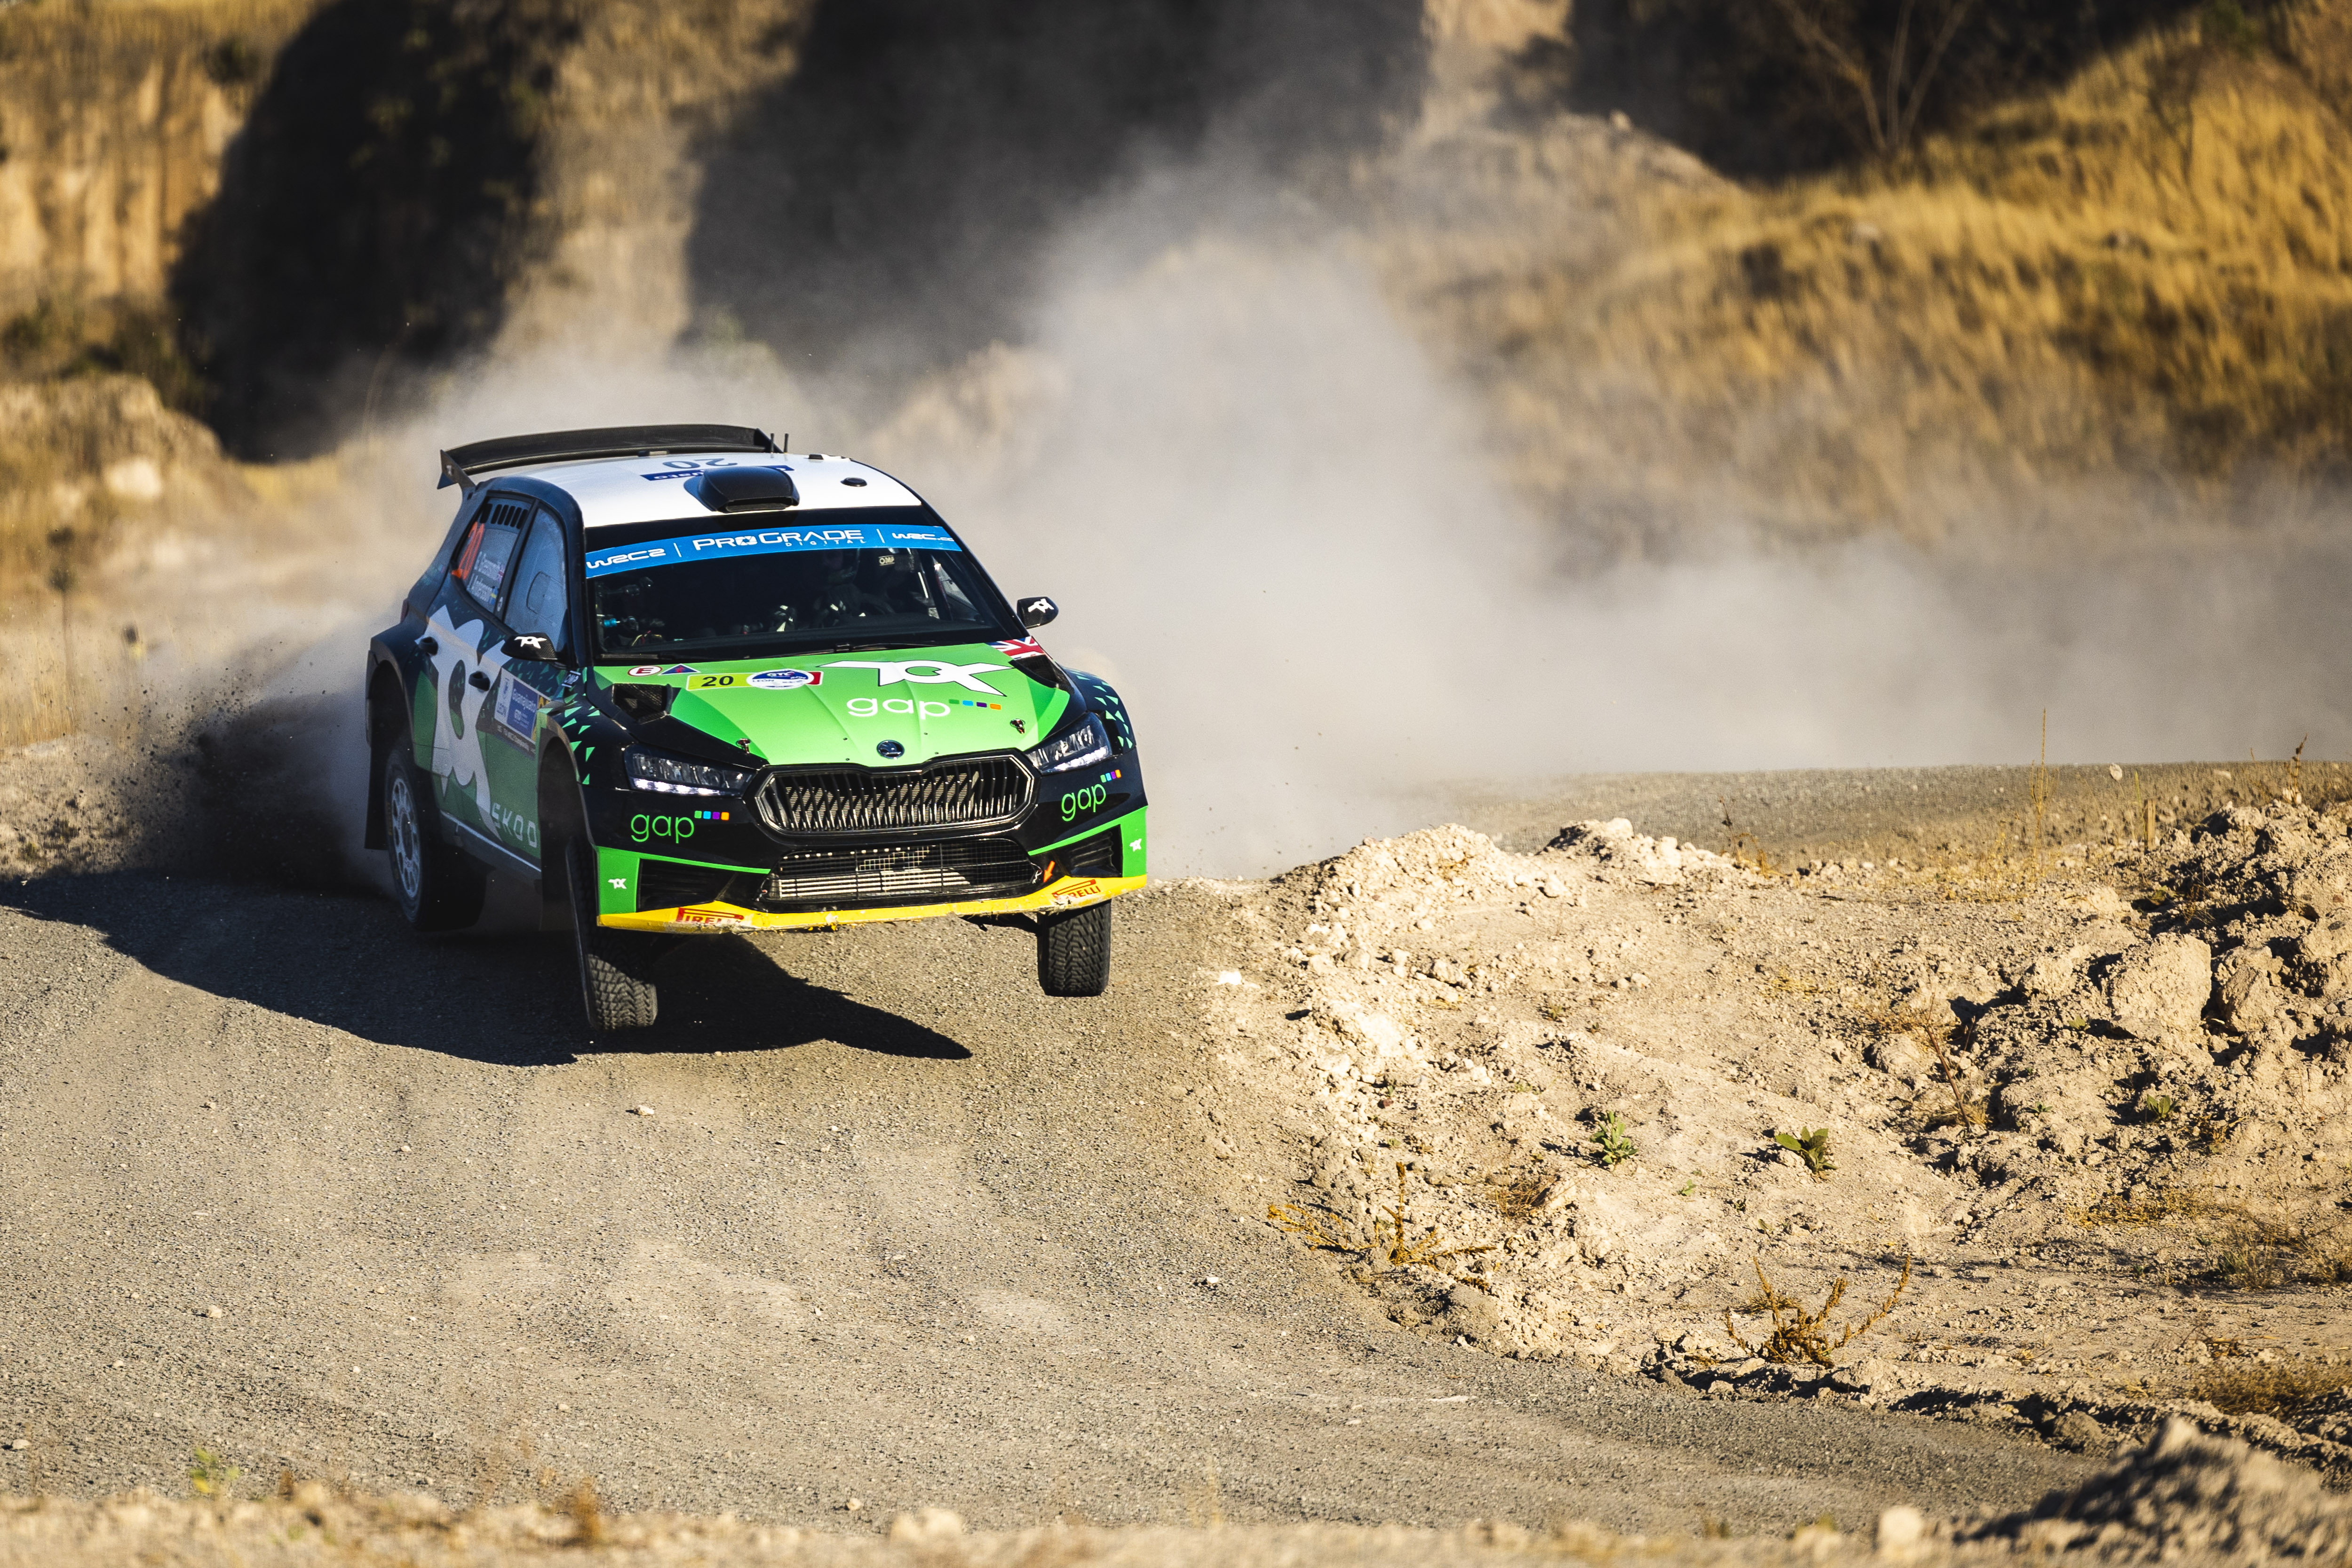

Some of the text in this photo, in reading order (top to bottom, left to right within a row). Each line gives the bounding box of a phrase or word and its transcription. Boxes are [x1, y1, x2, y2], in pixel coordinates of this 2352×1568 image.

[662, 458, 738, 469] 20
[586, 548, 666, 569] WRC2
[701, 676, 734, 687] 20
[846, 698, 951, 720] gap
[1061, 784, 1106, 821] gap
[631, 814, 694, 844] gap
